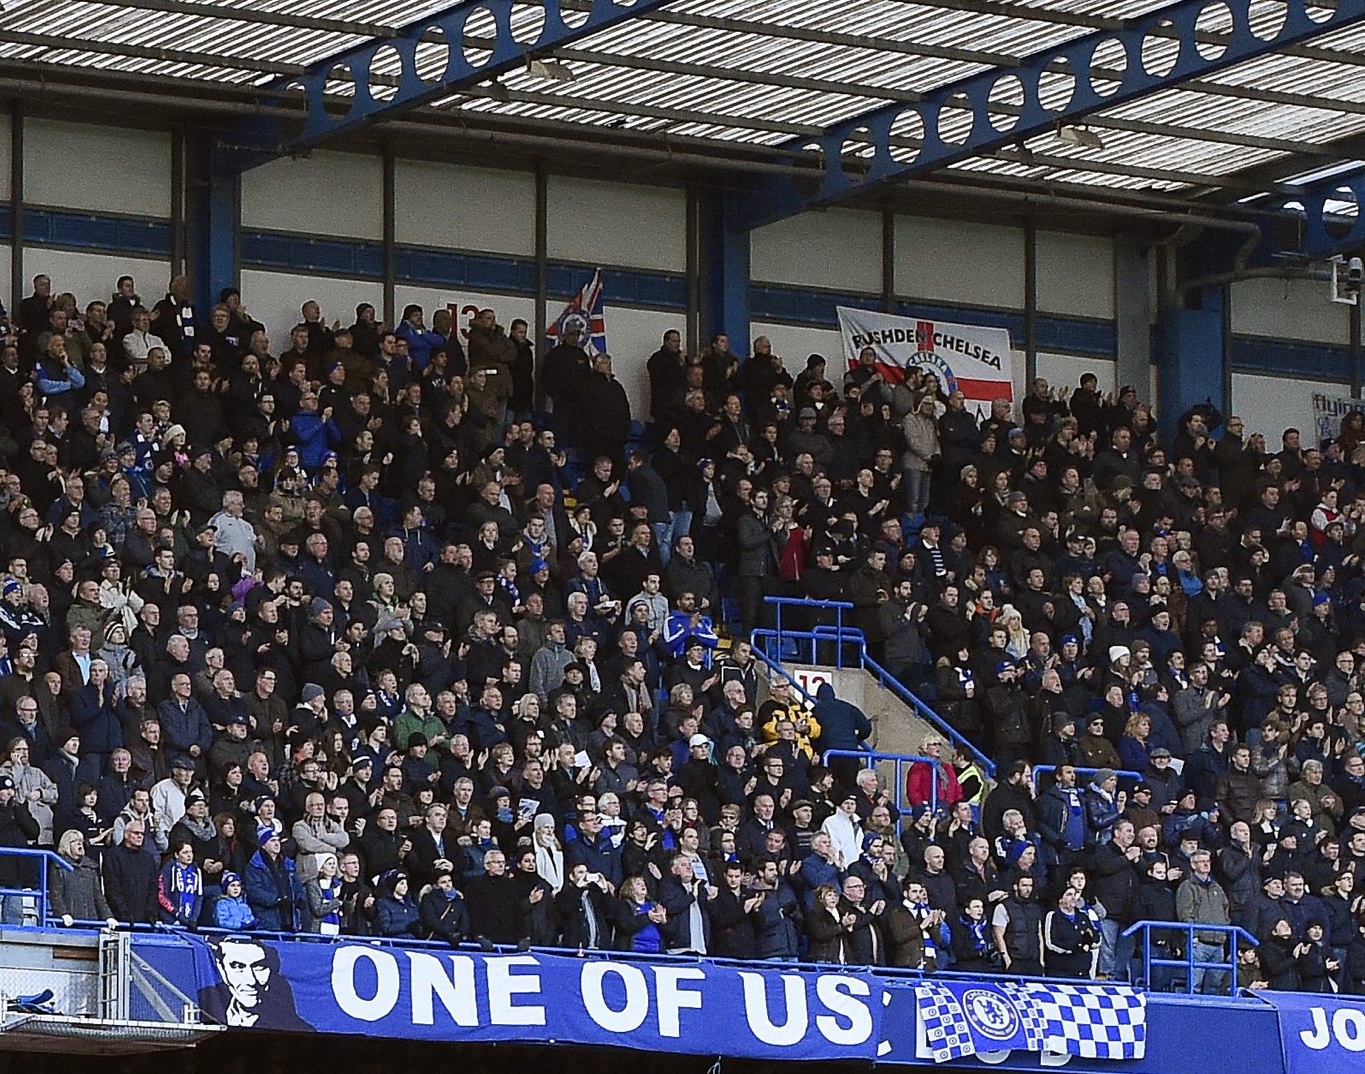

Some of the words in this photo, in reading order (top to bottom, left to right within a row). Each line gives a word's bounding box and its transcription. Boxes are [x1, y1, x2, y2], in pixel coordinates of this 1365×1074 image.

[851, 328, 928, 350] RUSHDEN
[933, 332, 1002, 371] CHELSEA
[331, 945, 547, 1027] ONE
[580, 961, 707, 1038] OF
[737, 971, 874, 1047] US
